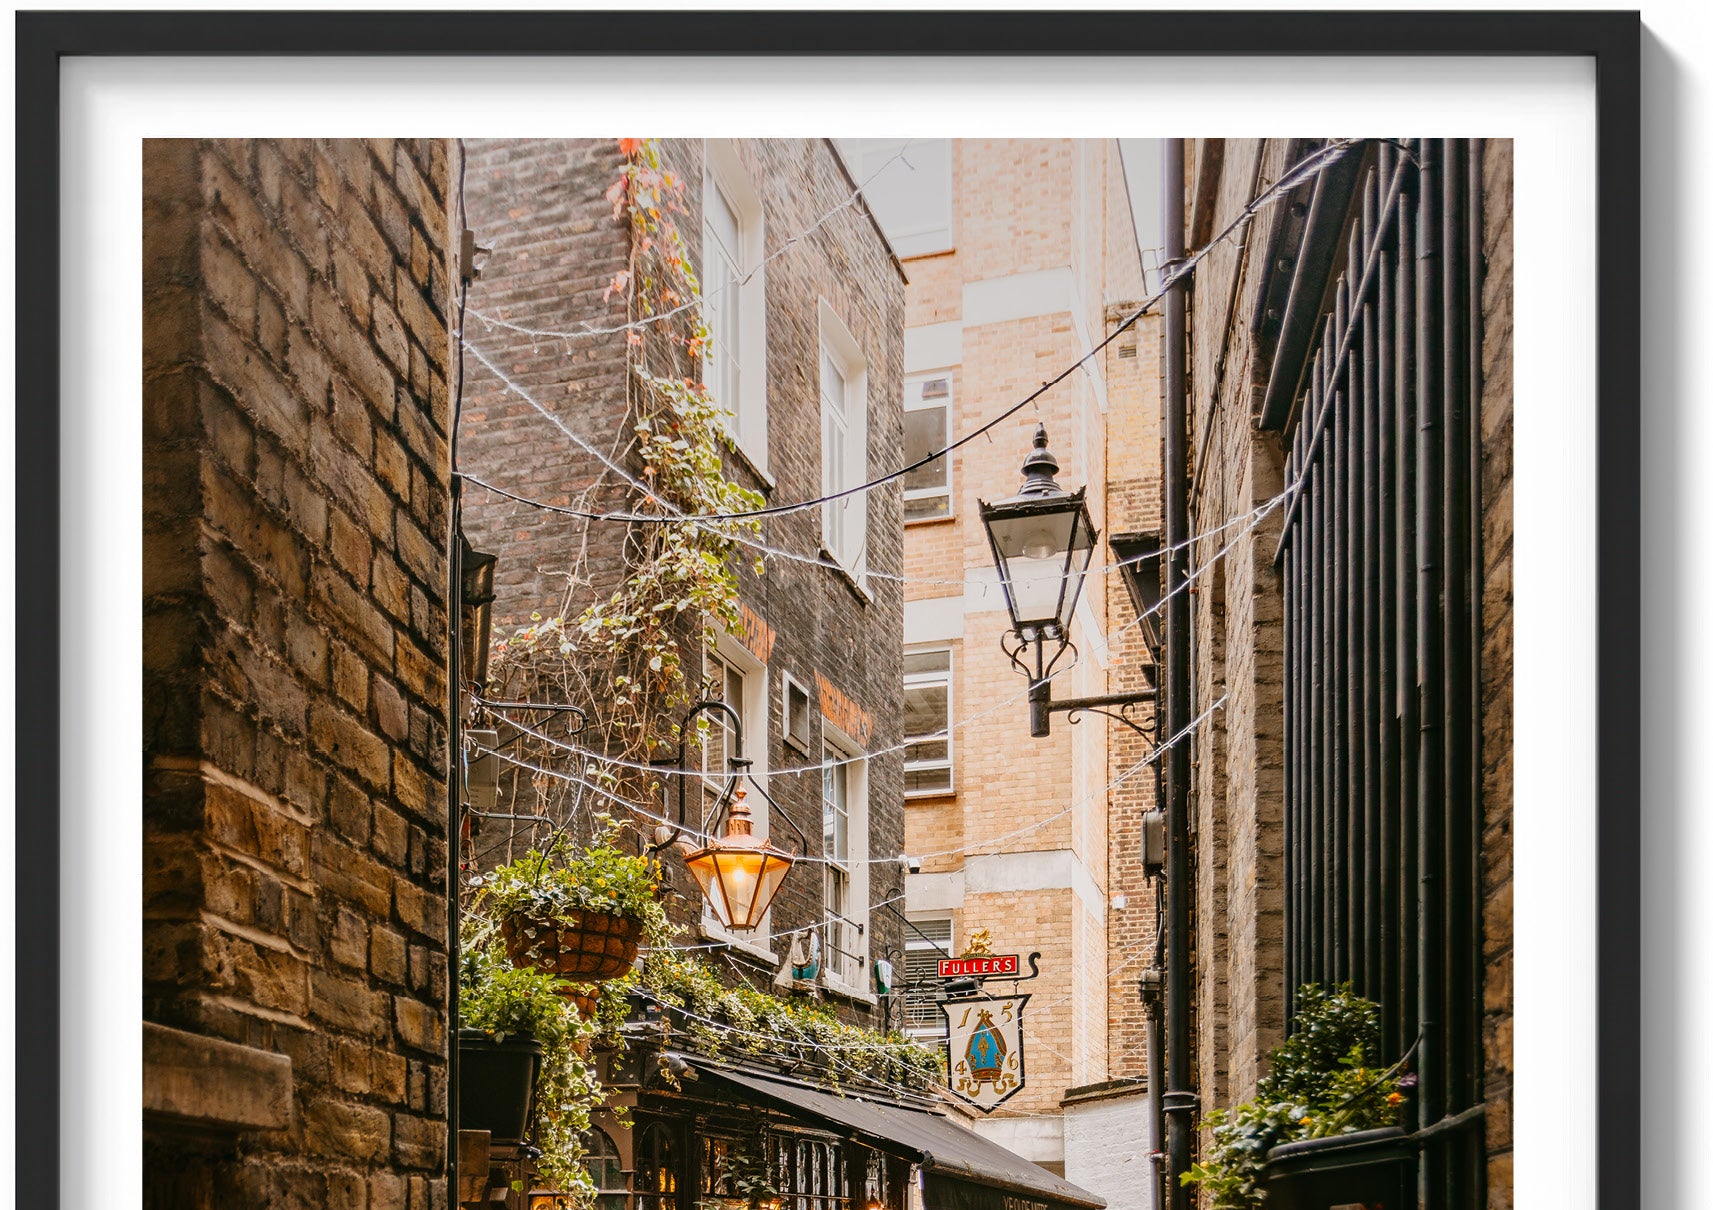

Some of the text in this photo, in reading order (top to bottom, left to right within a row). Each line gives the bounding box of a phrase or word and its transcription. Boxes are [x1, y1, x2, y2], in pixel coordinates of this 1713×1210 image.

[942, 960, 1012, 975] FULLER'S
[957, 1002, 1014, 1029] 1 5
[955, 1051, 1019, 1076] 4 6
